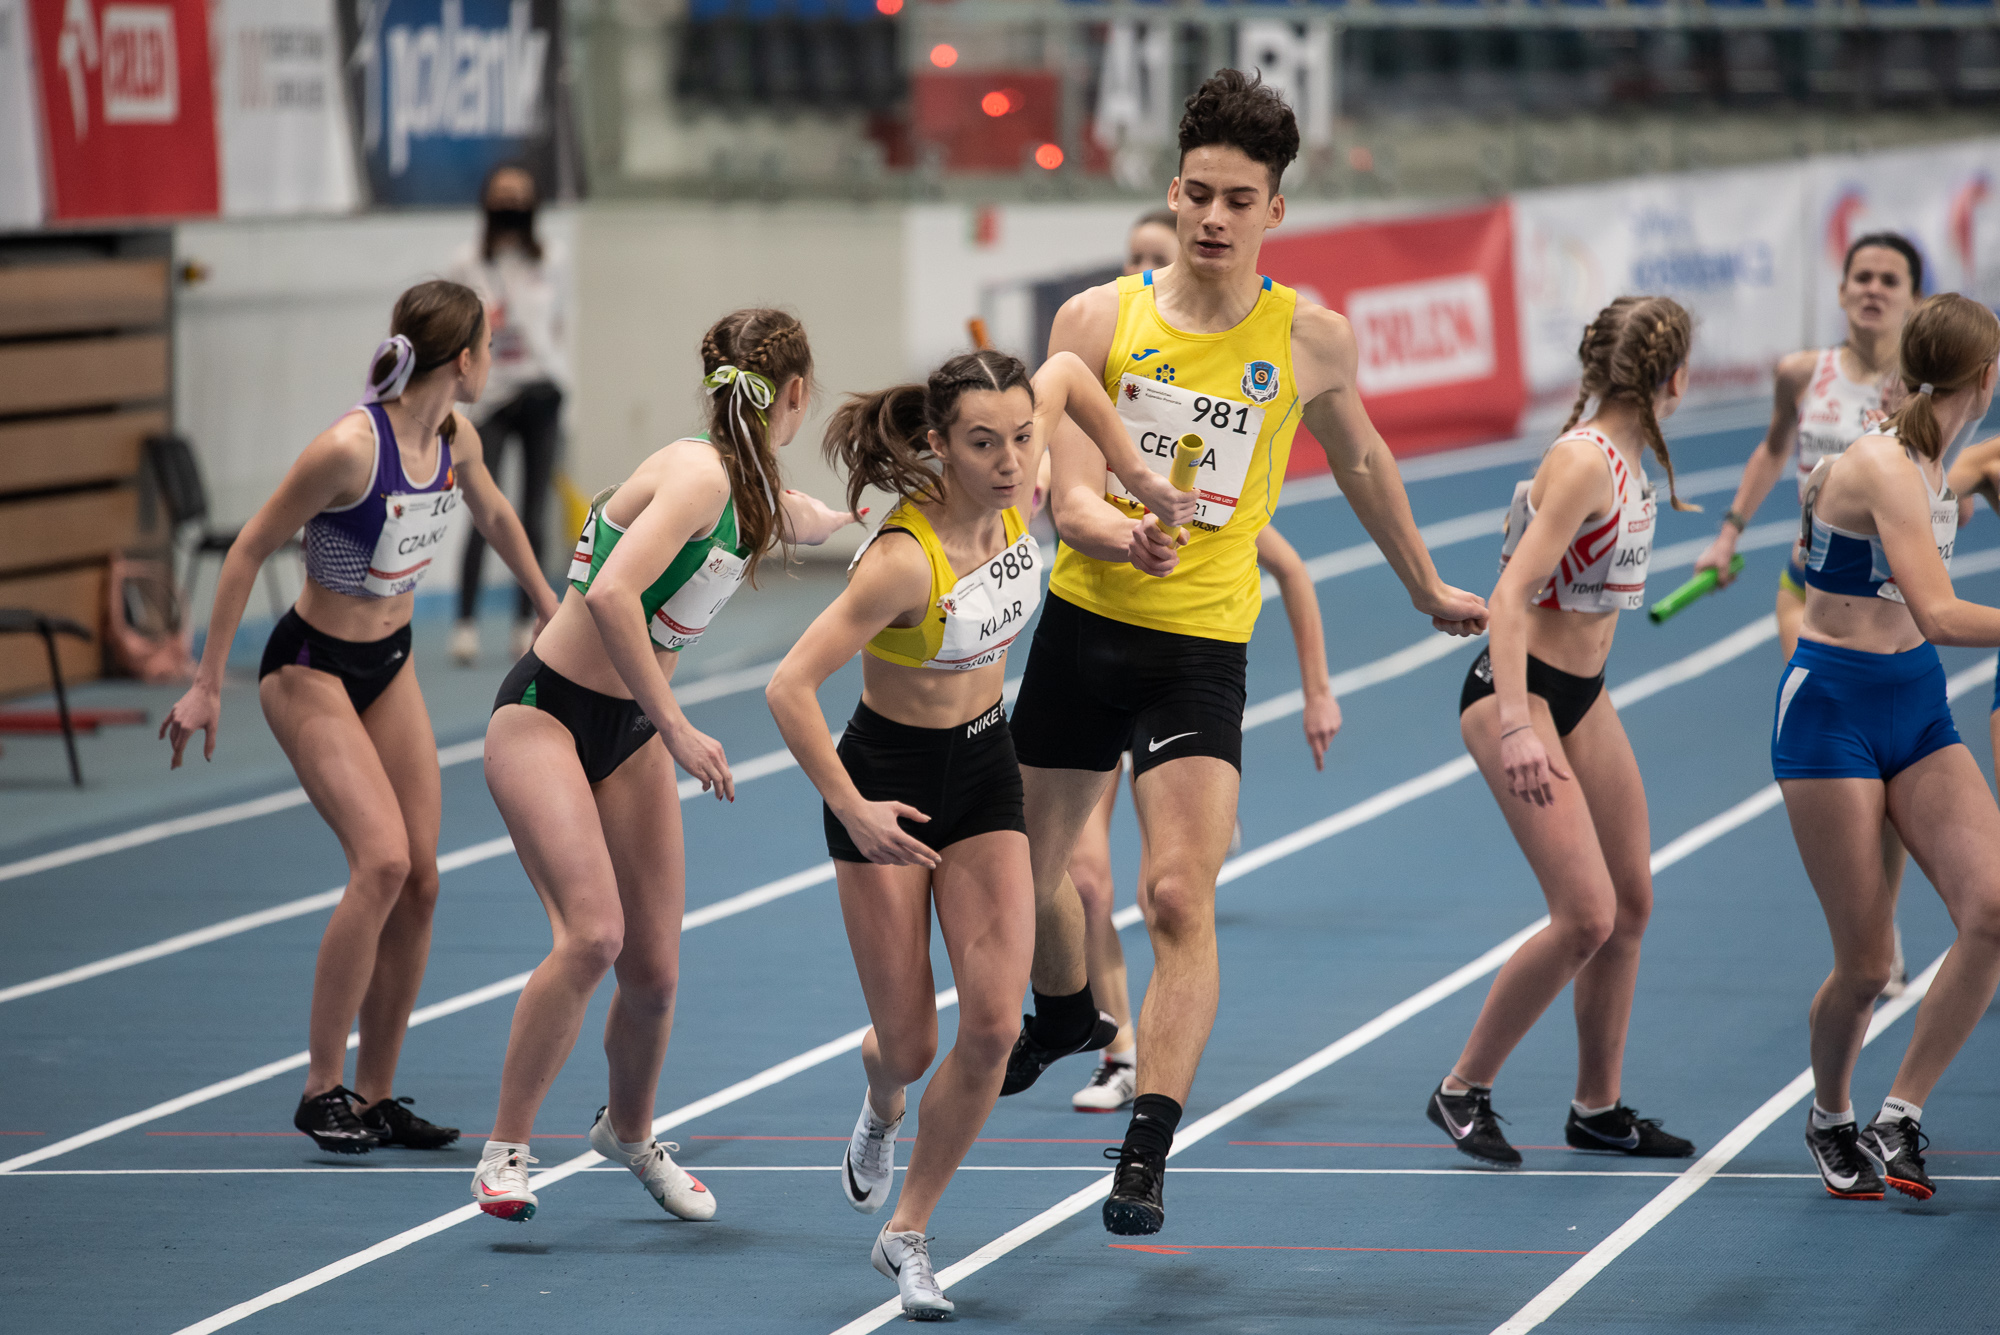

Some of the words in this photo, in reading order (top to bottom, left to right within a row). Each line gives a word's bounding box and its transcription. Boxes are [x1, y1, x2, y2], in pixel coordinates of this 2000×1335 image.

[1192, 396, 1249, 435] 981
[990, 544, 1034, 589] 988
[979, 600, 1022, 640] KLAR
[967, 707, 999, 739] NIKE
